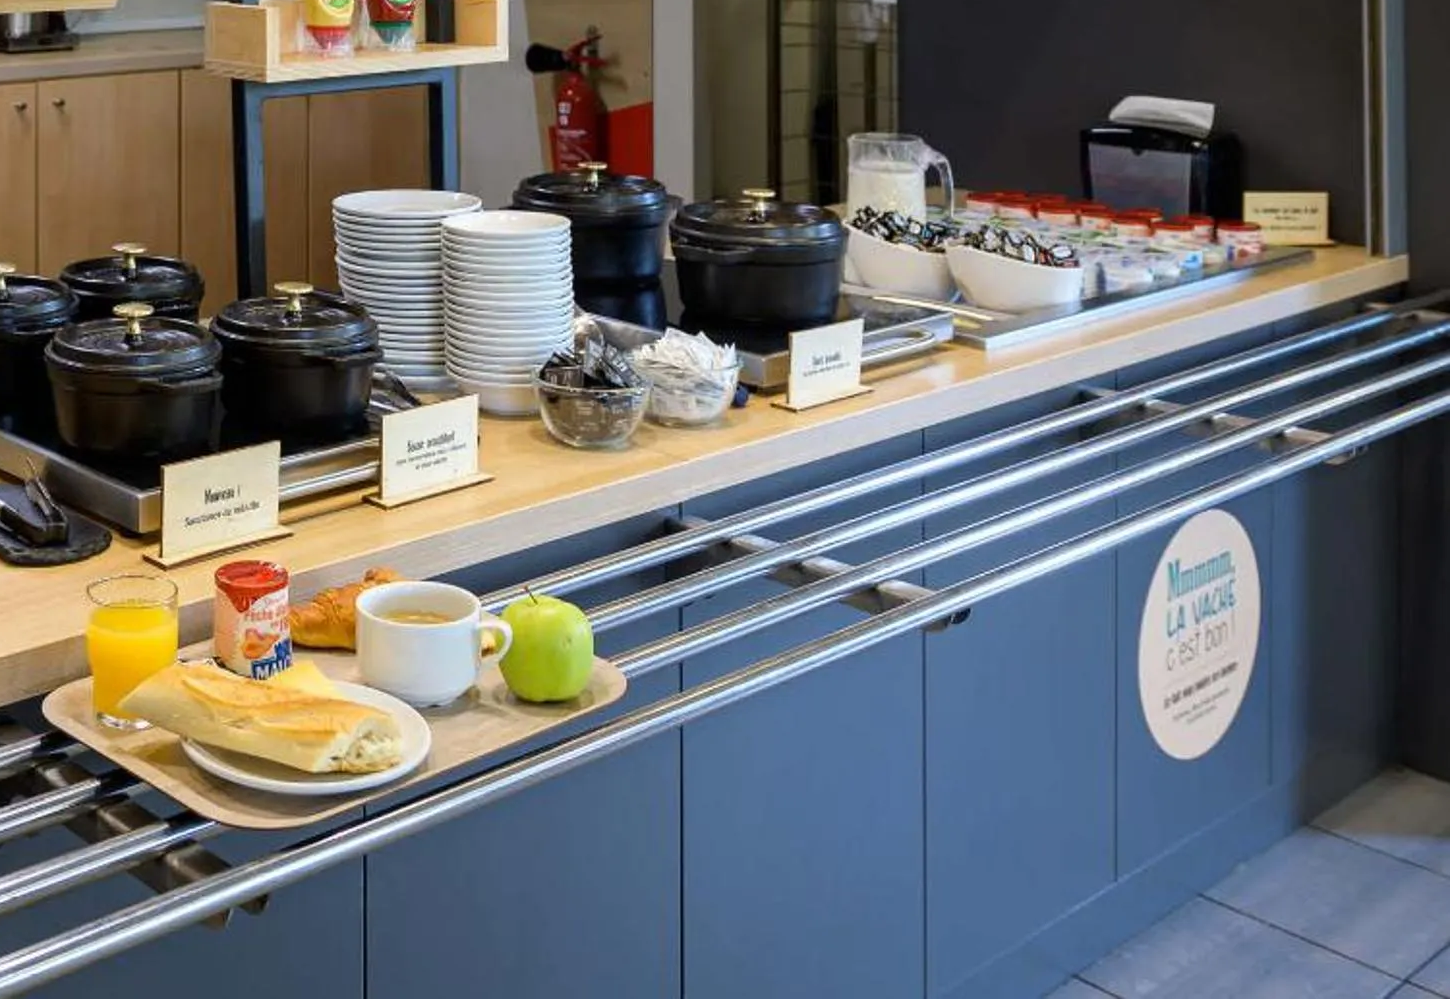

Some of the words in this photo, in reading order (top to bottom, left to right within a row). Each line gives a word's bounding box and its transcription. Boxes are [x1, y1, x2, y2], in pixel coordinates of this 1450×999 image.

[1166, 604, 1186, 637] LA
[1192, 578, 1237, 625] VACHE
[1205, 620, 1228, 653] bon
